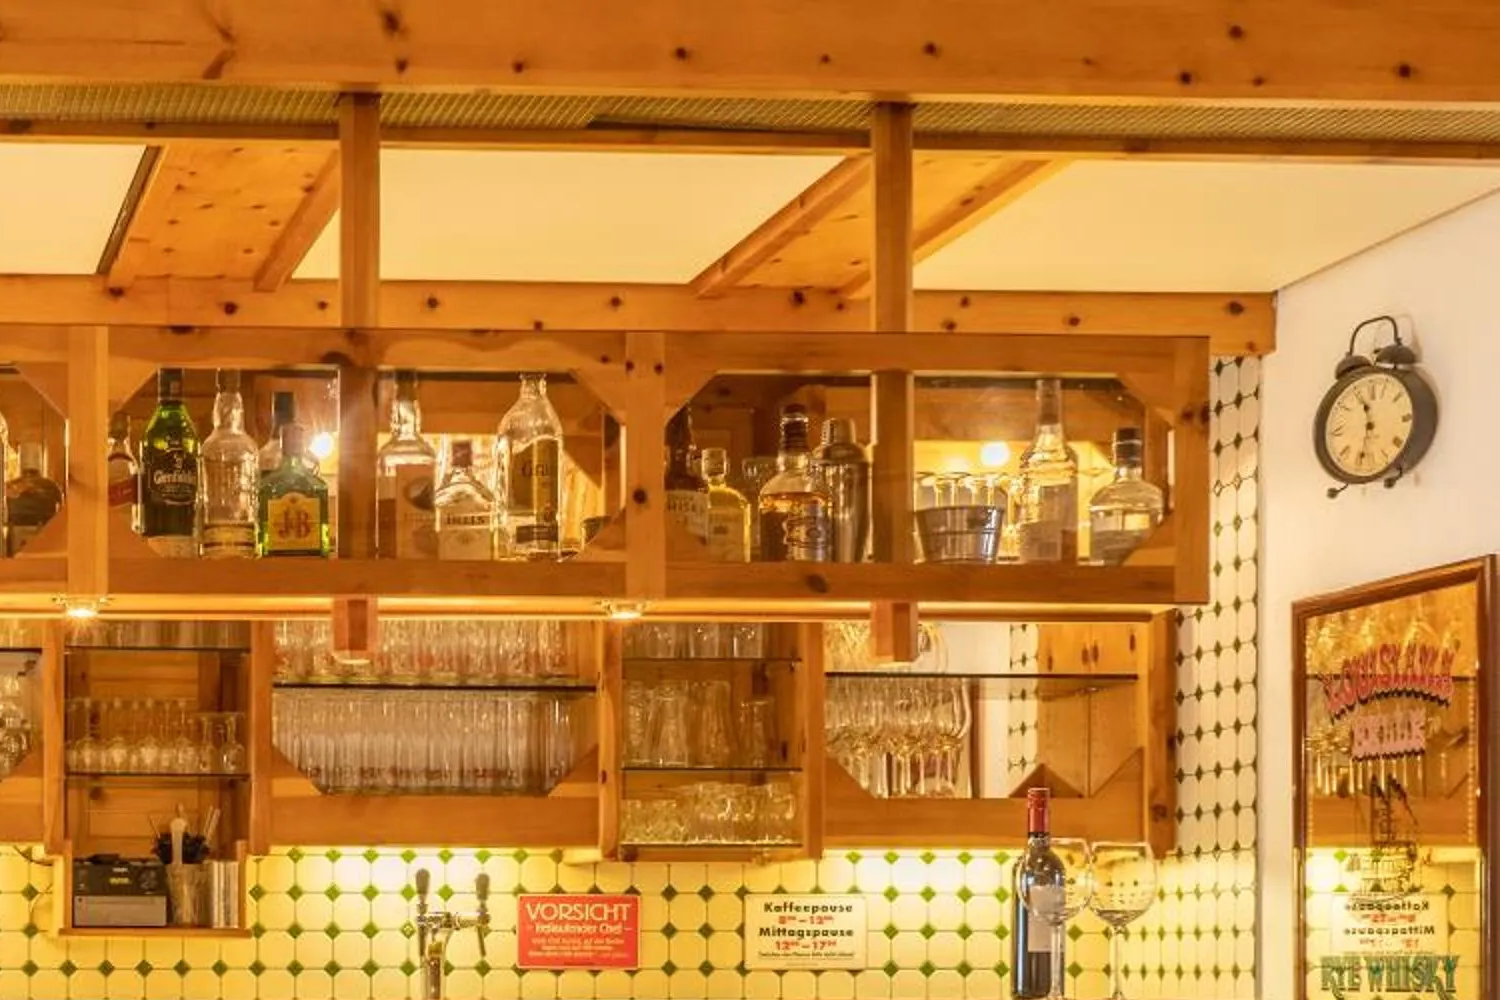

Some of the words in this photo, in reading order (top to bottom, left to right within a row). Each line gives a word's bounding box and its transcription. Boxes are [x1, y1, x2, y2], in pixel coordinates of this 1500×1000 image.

[525, 903, 632, 921] VORSICHT
[763, 902, 853, 914] Kaffeepause
[759, 926, 854, 940] Mittagspause
[1320, 955, 1362, 1000] RYE
